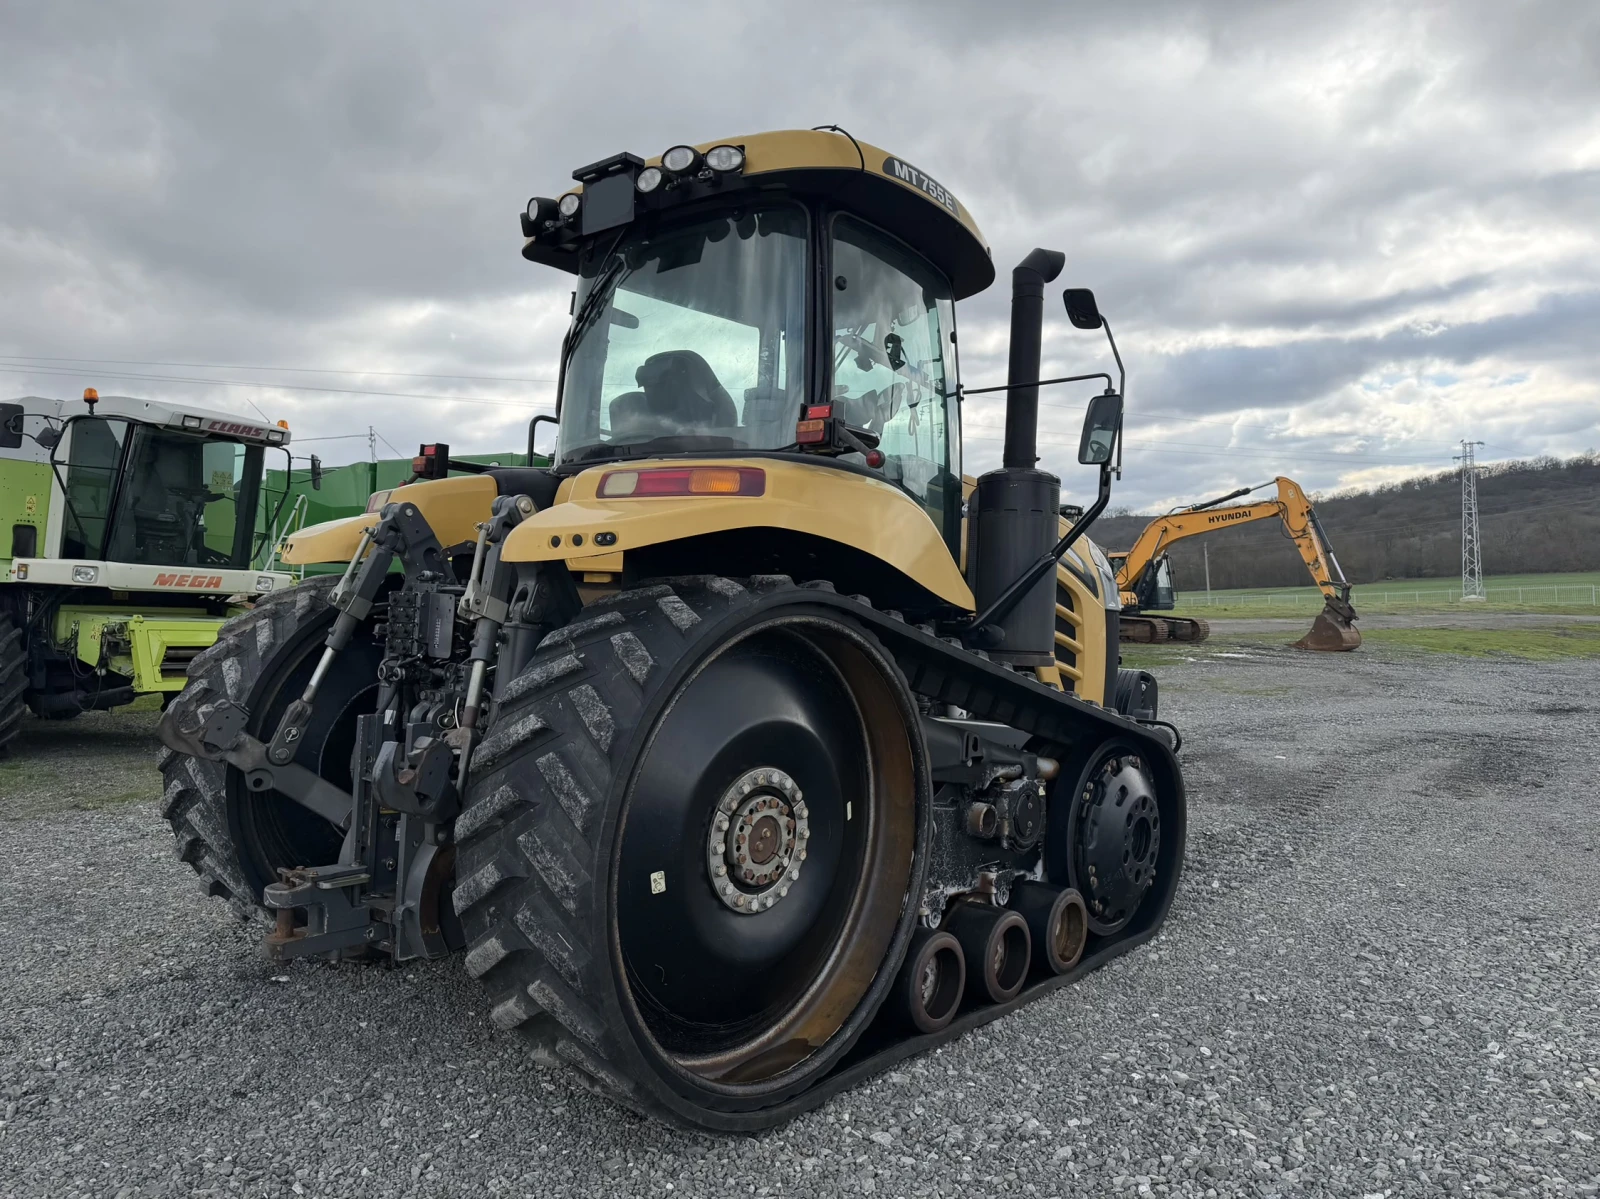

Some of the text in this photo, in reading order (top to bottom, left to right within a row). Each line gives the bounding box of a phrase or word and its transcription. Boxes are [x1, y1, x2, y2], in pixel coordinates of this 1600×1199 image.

[207, 421, 265, 437] CLAAS
[1208, 510, 1252, 524] HYUNDAI
[152, 572, 223, 589] MEGA
